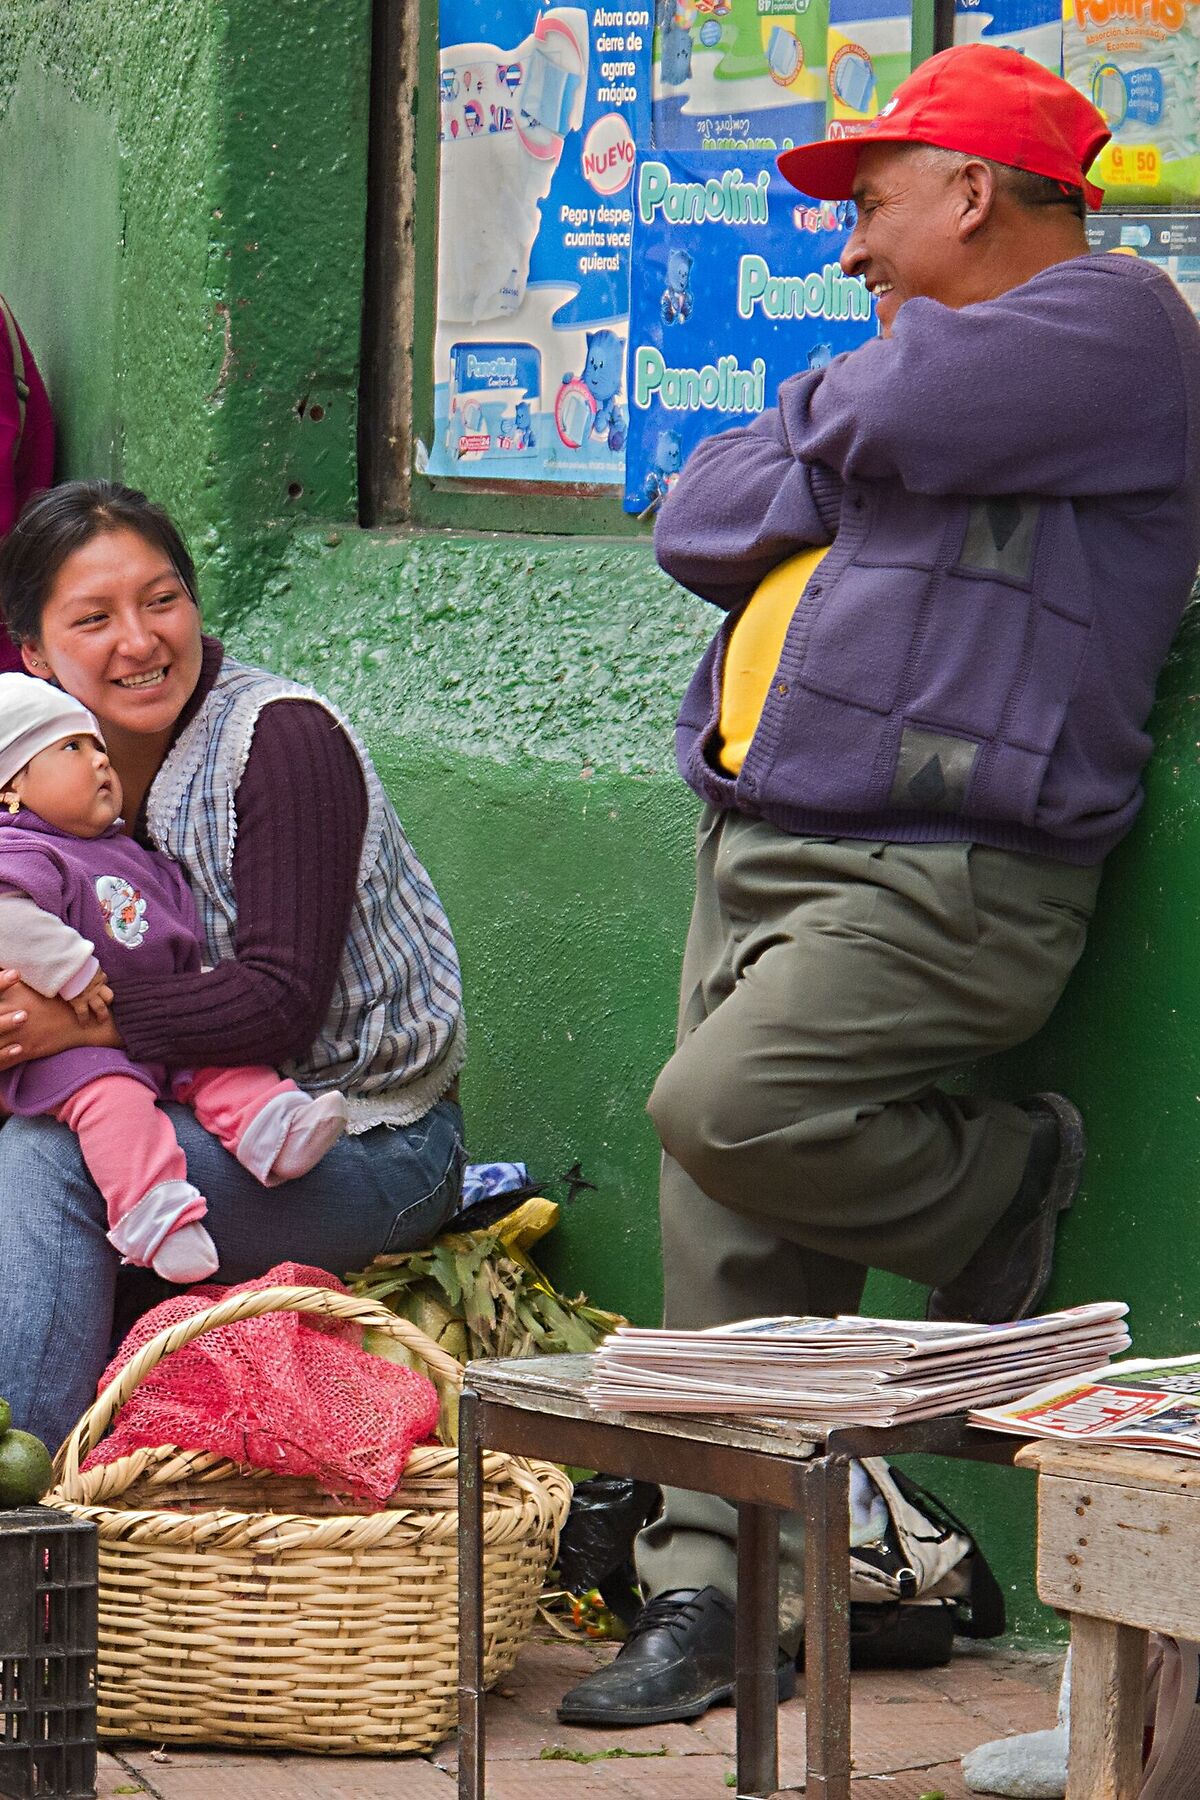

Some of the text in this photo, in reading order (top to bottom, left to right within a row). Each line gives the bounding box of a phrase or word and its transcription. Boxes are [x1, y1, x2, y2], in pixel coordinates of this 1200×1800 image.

[593, 7, 650, 27] Ahora con
[596, 31, 643, 52] cierre de
[601, 61, 636, 81] agarre
[597, 82, 638, 106] mágico
[715, 114, 750, 136] Comfort
[584, 140, 635, 175] NUEVO
[1111, 146, 1157, 172] G 50
[639, 161, 771, 225] Panolini
[561, 204, 632, 227] Pega y despe
[564, 231, 631, 247] cuantas vece
[579, 252, 620, 274] quieras!
[635, 345, 766, 413] Panolini
